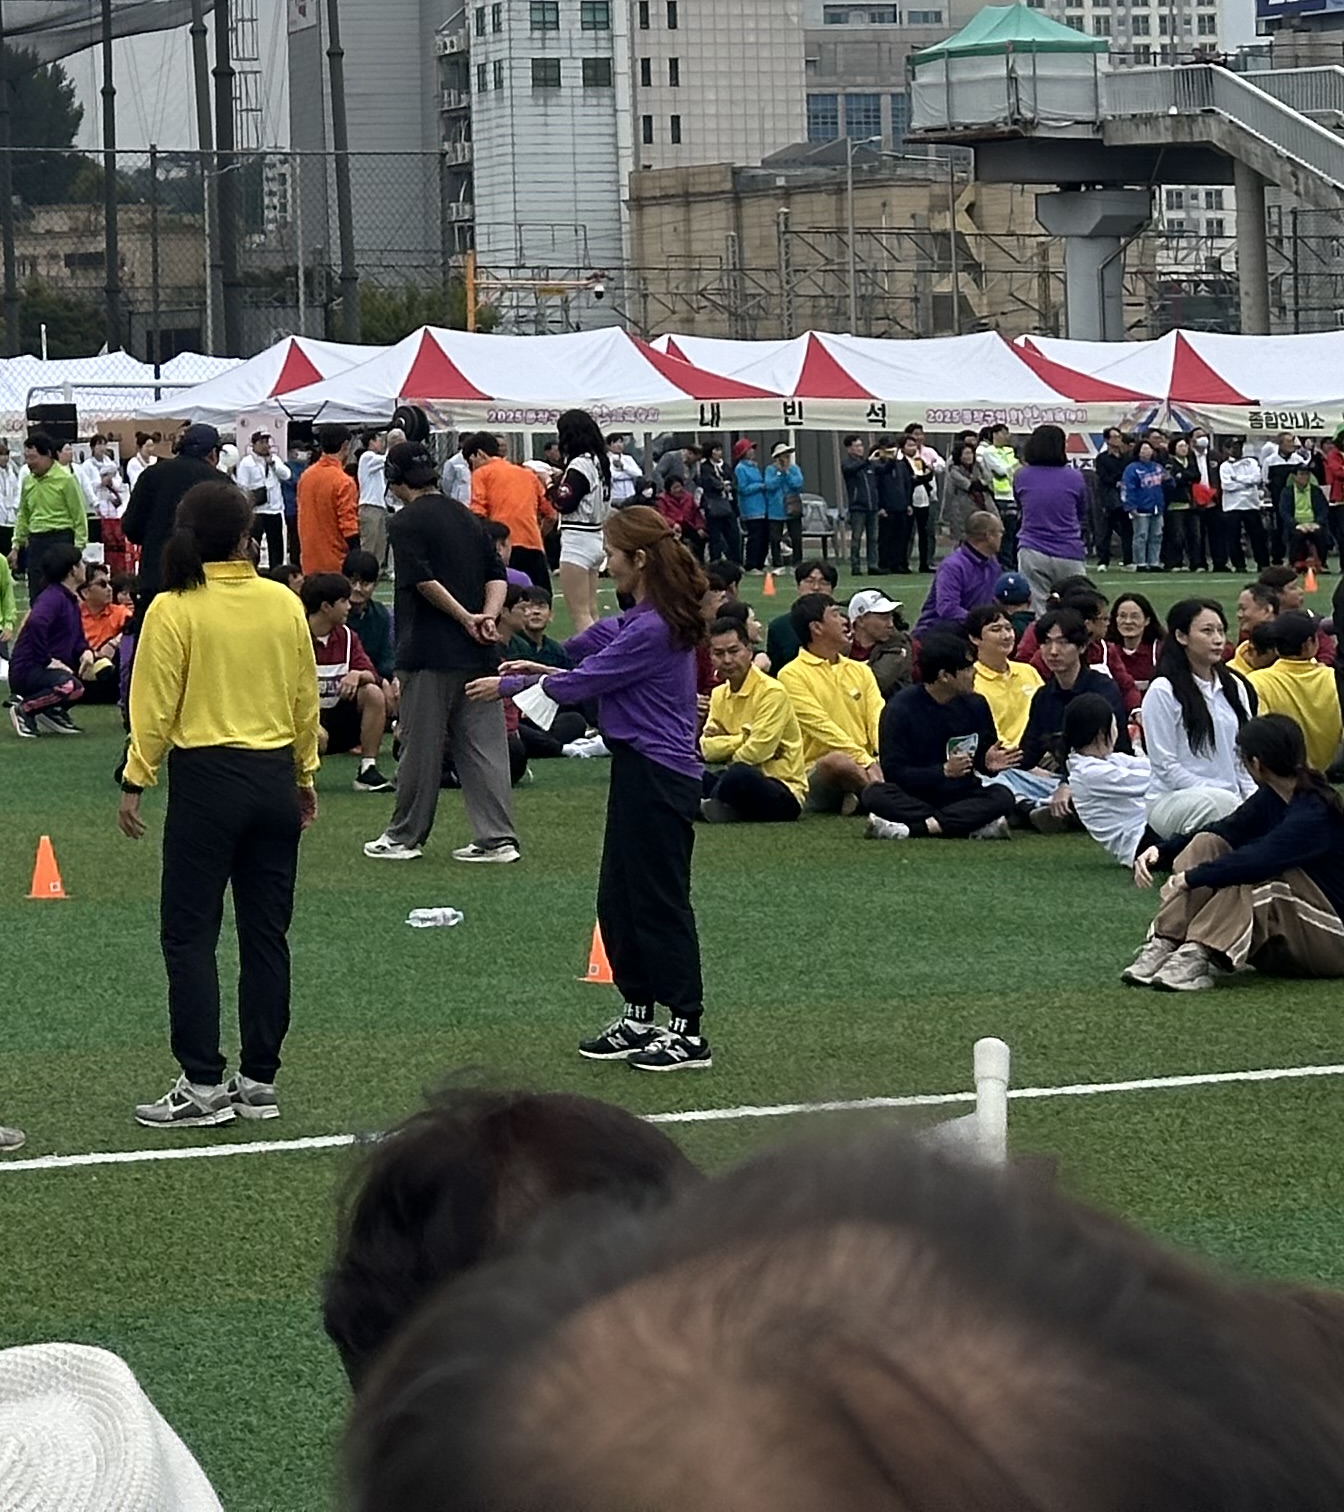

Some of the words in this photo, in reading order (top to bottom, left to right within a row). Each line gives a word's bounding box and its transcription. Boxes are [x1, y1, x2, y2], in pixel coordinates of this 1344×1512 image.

[486, 408, 525, 424] 2025
[524, 408, 561, 426] 동작구
[925, 408, 960, 425] 2025
[1248, 410, 1326, 430] 종합안내소
